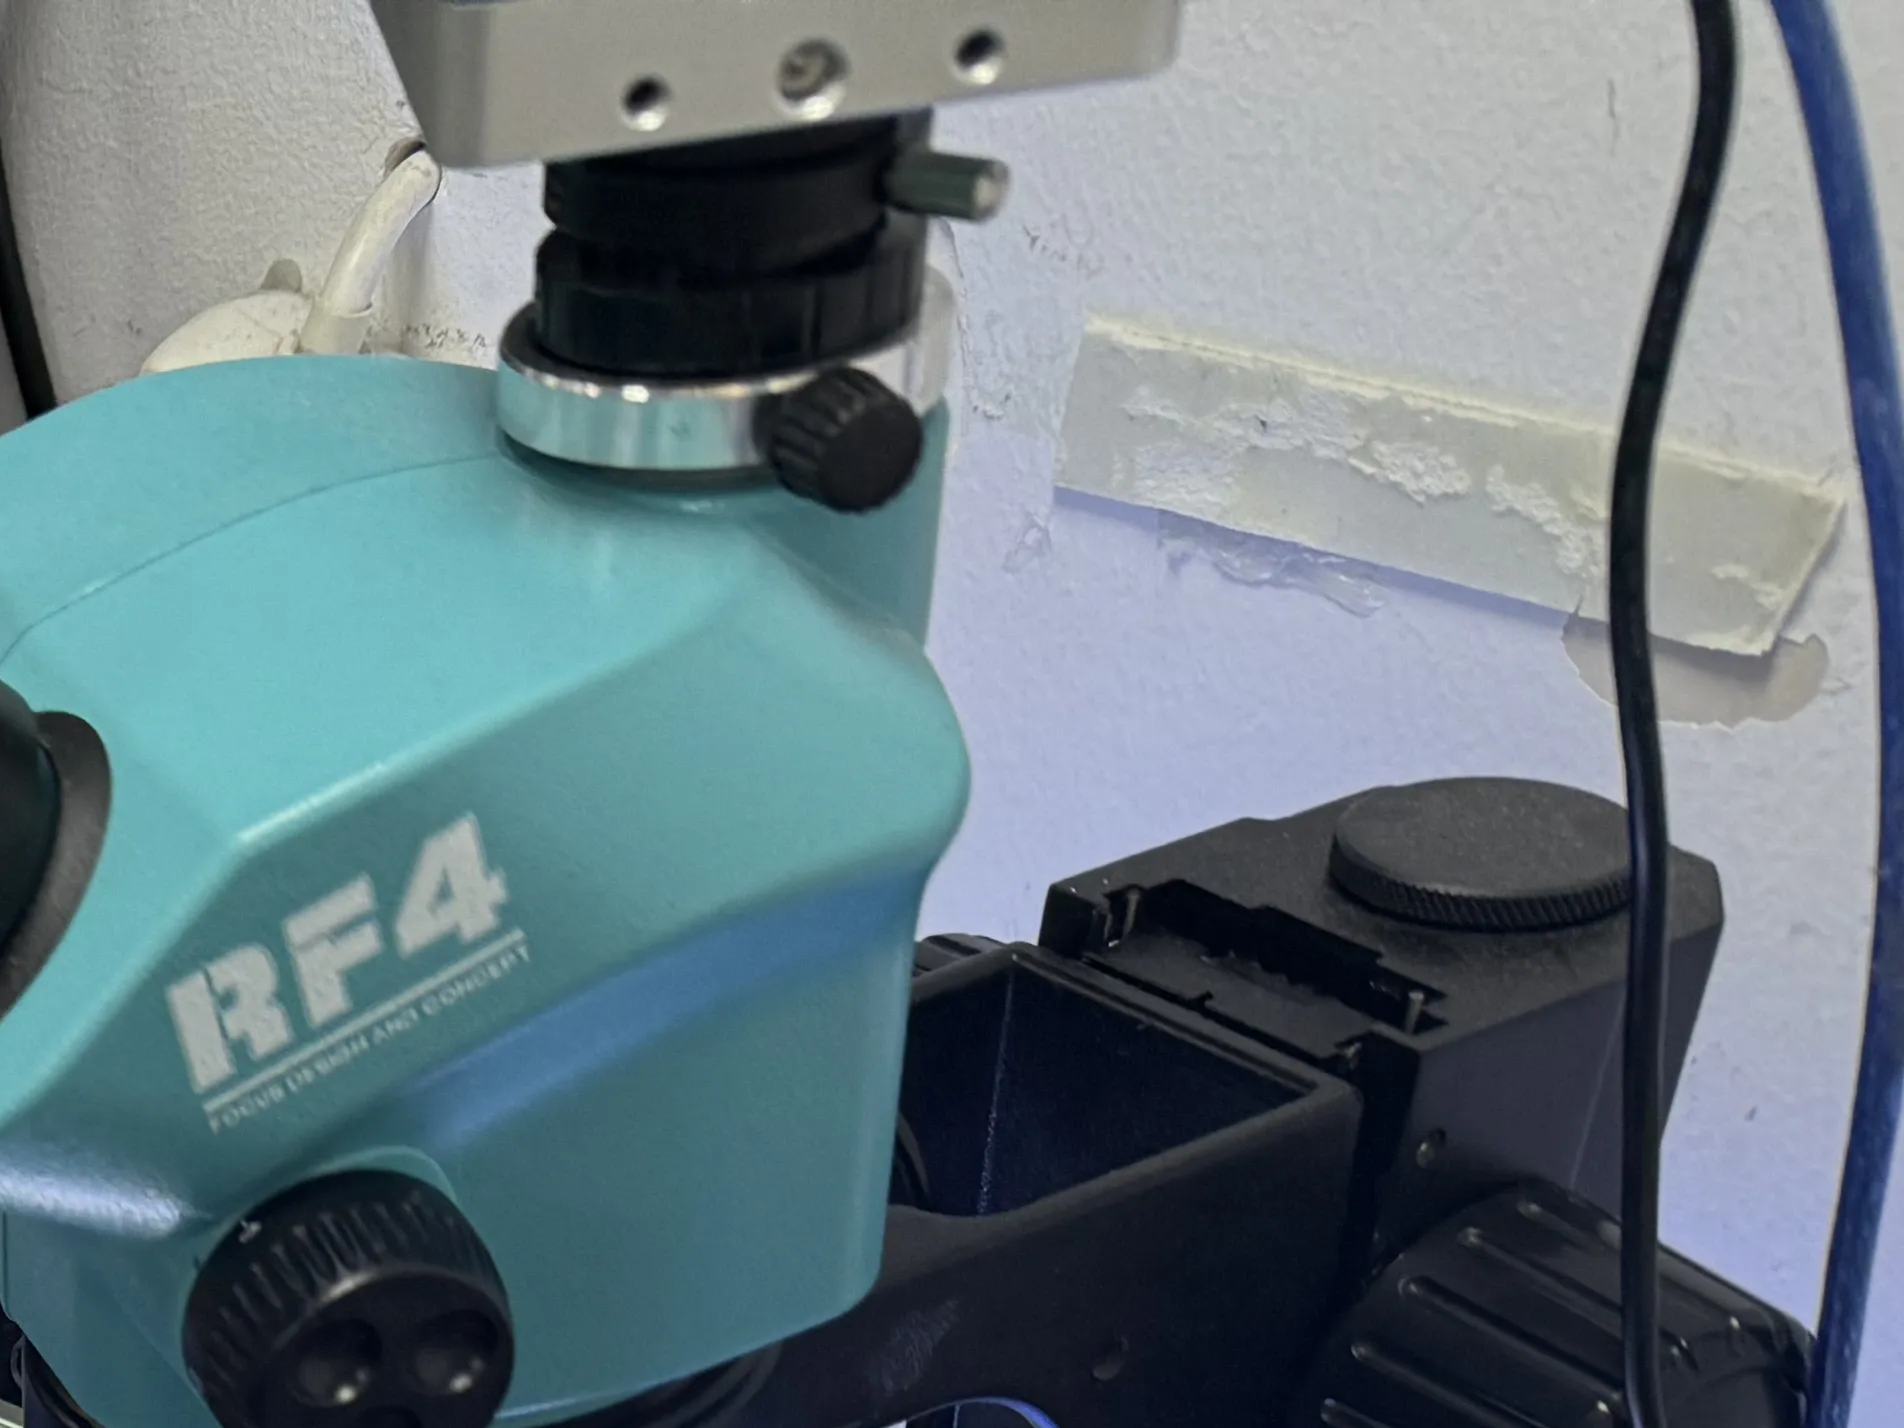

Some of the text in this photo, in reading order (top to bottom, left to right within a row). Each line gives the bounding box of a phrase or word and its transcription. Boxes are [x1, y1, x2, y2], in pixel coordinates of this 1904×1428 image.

[167, 812, 509, 1093] RF4
[288, 1034, 369, 1095] DESIGN
[372, 1008, 418, 1053] AND
[421, 942, 532, 1017] CONCEPT
